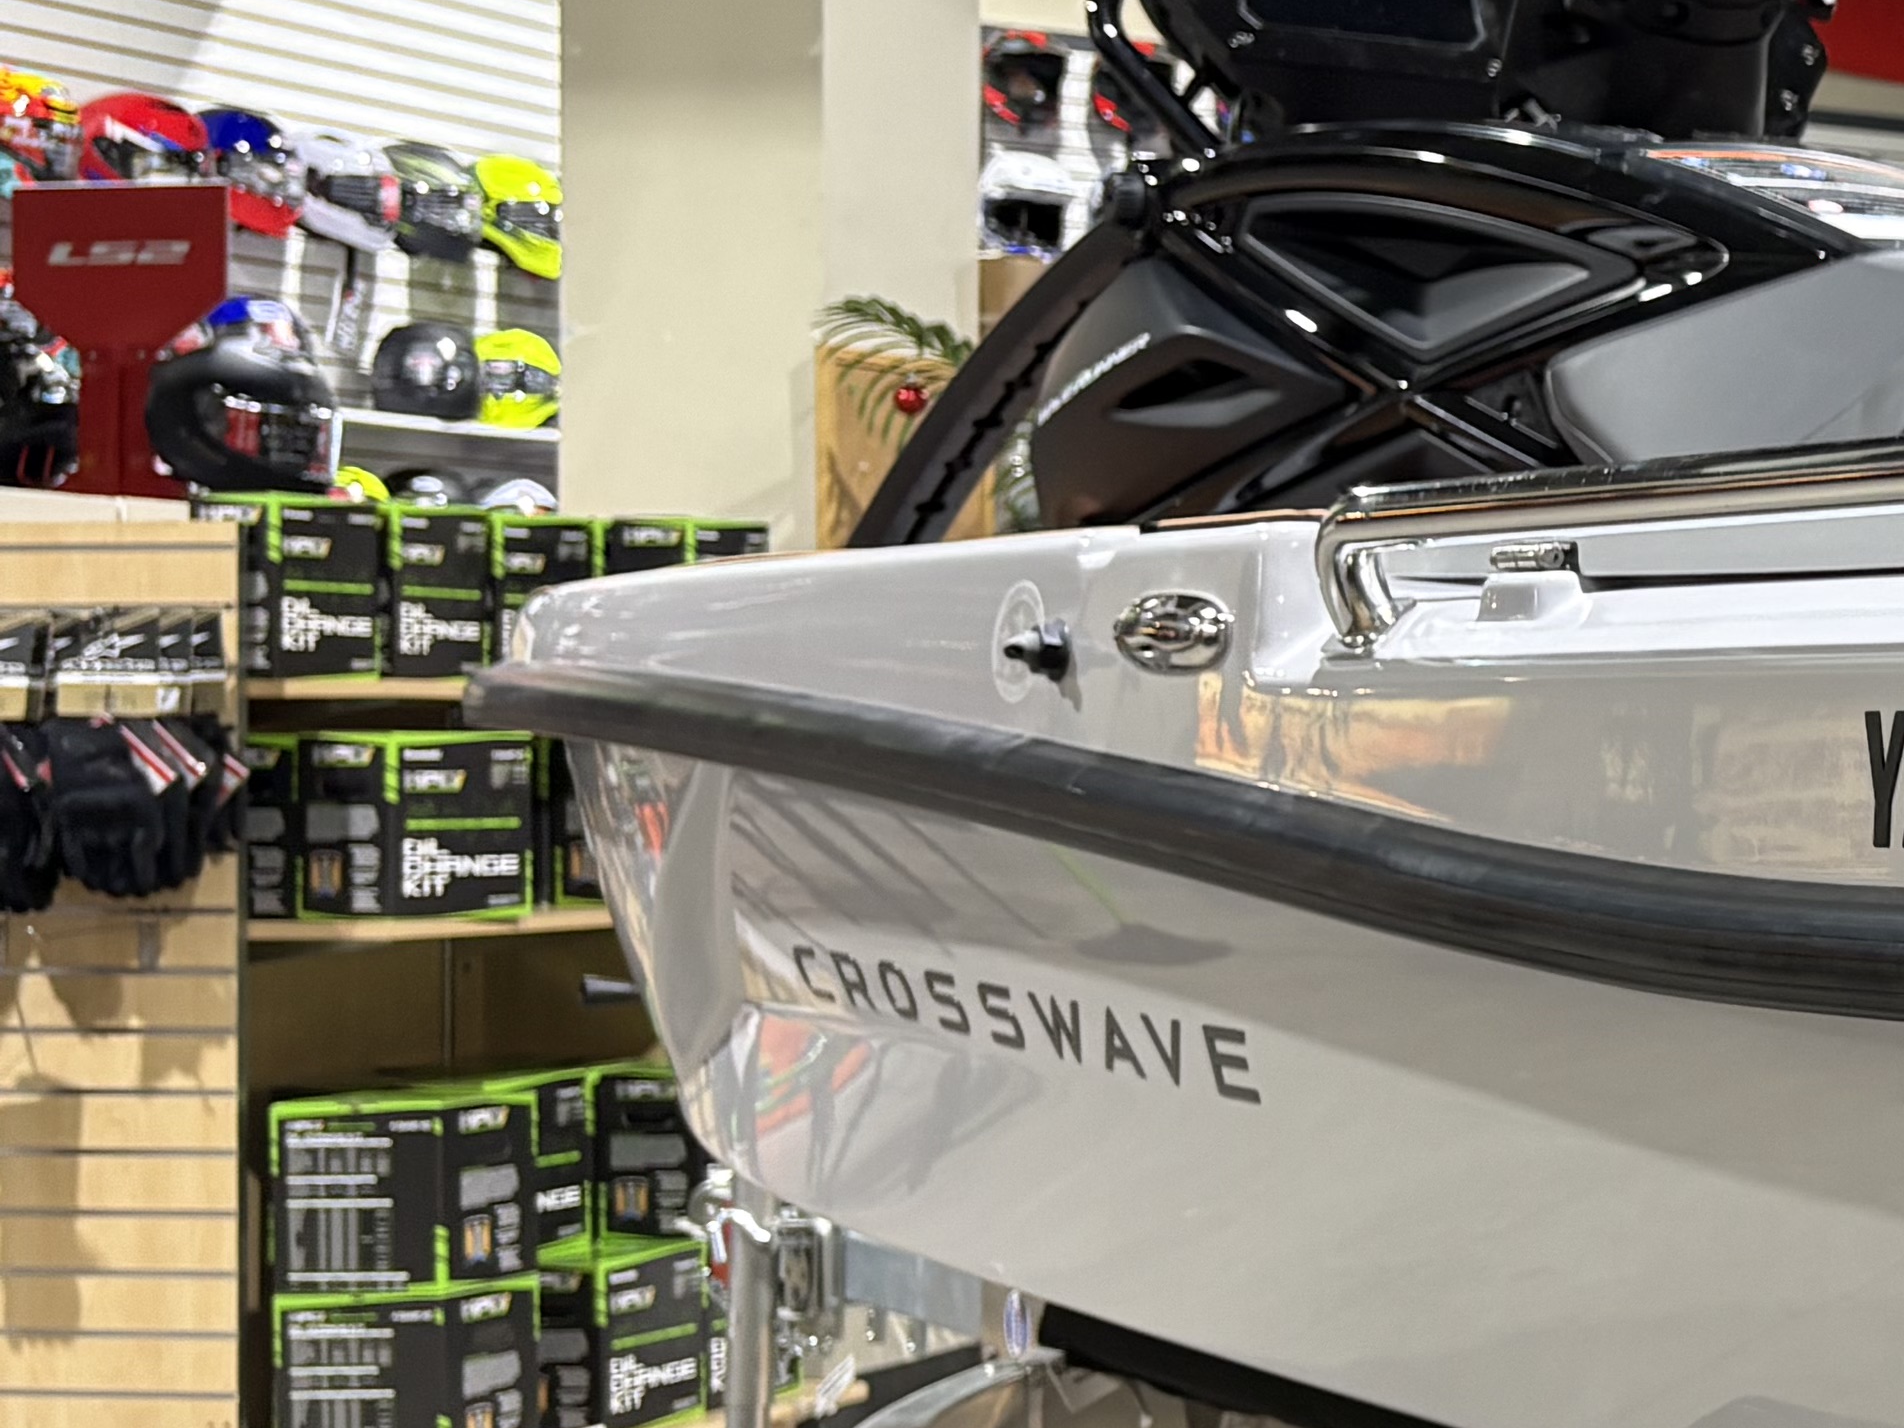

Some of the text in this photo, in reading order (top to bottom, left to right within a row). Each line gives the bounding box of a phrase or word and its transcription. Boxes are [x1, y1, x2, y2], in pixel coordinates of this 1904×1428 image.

[48, 240, 191, 266] LS2
[402, 853, 521, 877] CHANGE
[402, 874, 449, 898] KIT
[793, 945, 1261, 1105] CROSSWAVE
[535, 1184, 582, 1214] NGE
